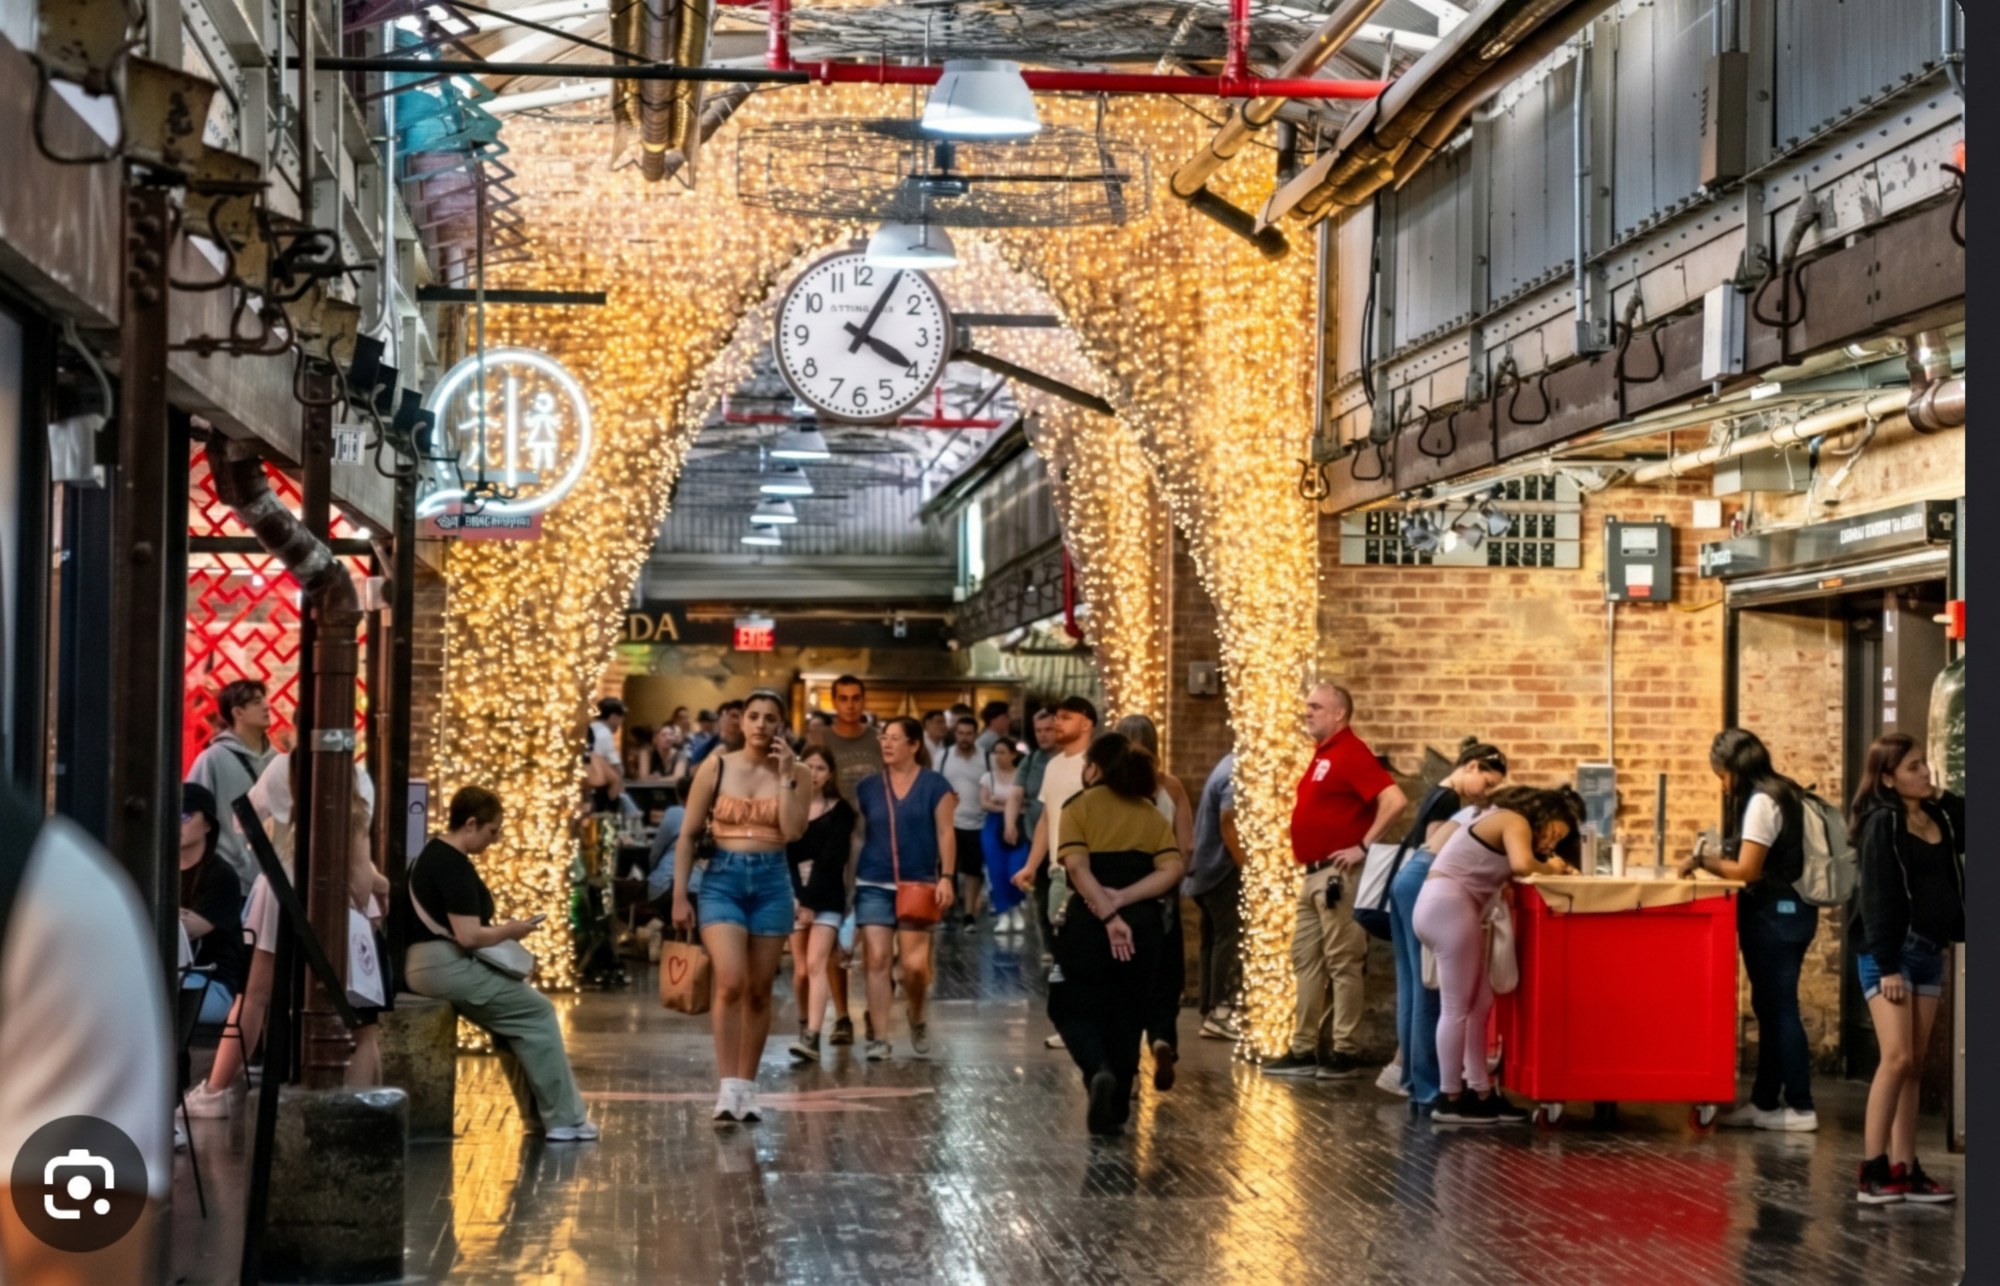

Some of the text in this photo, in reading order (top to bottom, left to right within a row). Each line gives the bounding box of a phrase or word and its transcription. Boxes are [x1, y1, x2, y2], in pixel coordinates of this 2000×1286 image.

[831, 272, 844, 293] 11
[854, 266, 873, 287] 12
[806, 292, 823, 314] 10
[906, 294, 922, 316] 2
[794, 324, 810, 346] 9
[914, 327, 929, 348] 3
[802, 357, 818, 379] 8
[904, 361, 920, 381] 4
[829, 377, 845, 399] 7
[851, 386, 868, 408] 6
[878, 378, 895, 401] 5
